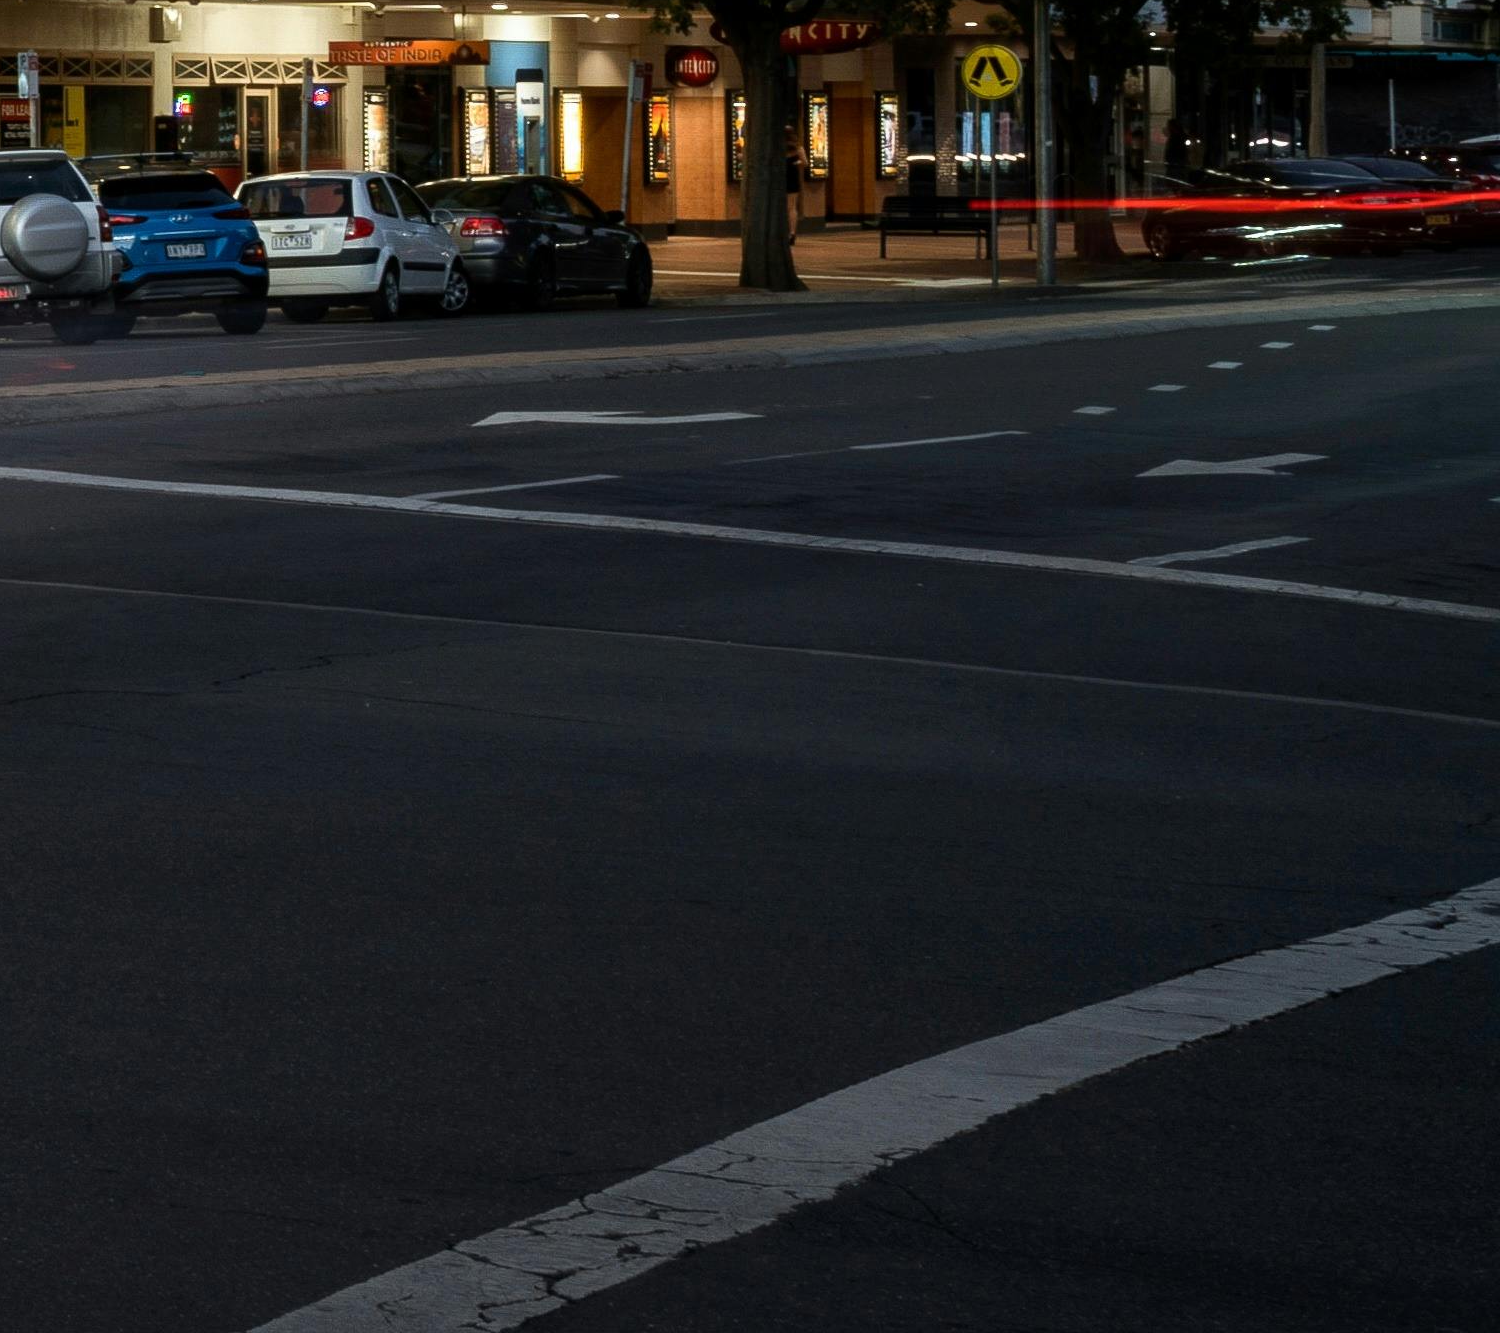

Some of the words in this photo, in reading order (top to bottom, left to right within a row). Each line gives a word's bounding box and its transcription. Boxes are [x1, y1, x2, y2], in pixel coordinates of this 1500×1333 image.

[330, 50, 371, 62] TASTE
[375, 48, 396, 62] OF
[402, 48, 442, 62] INDIA
